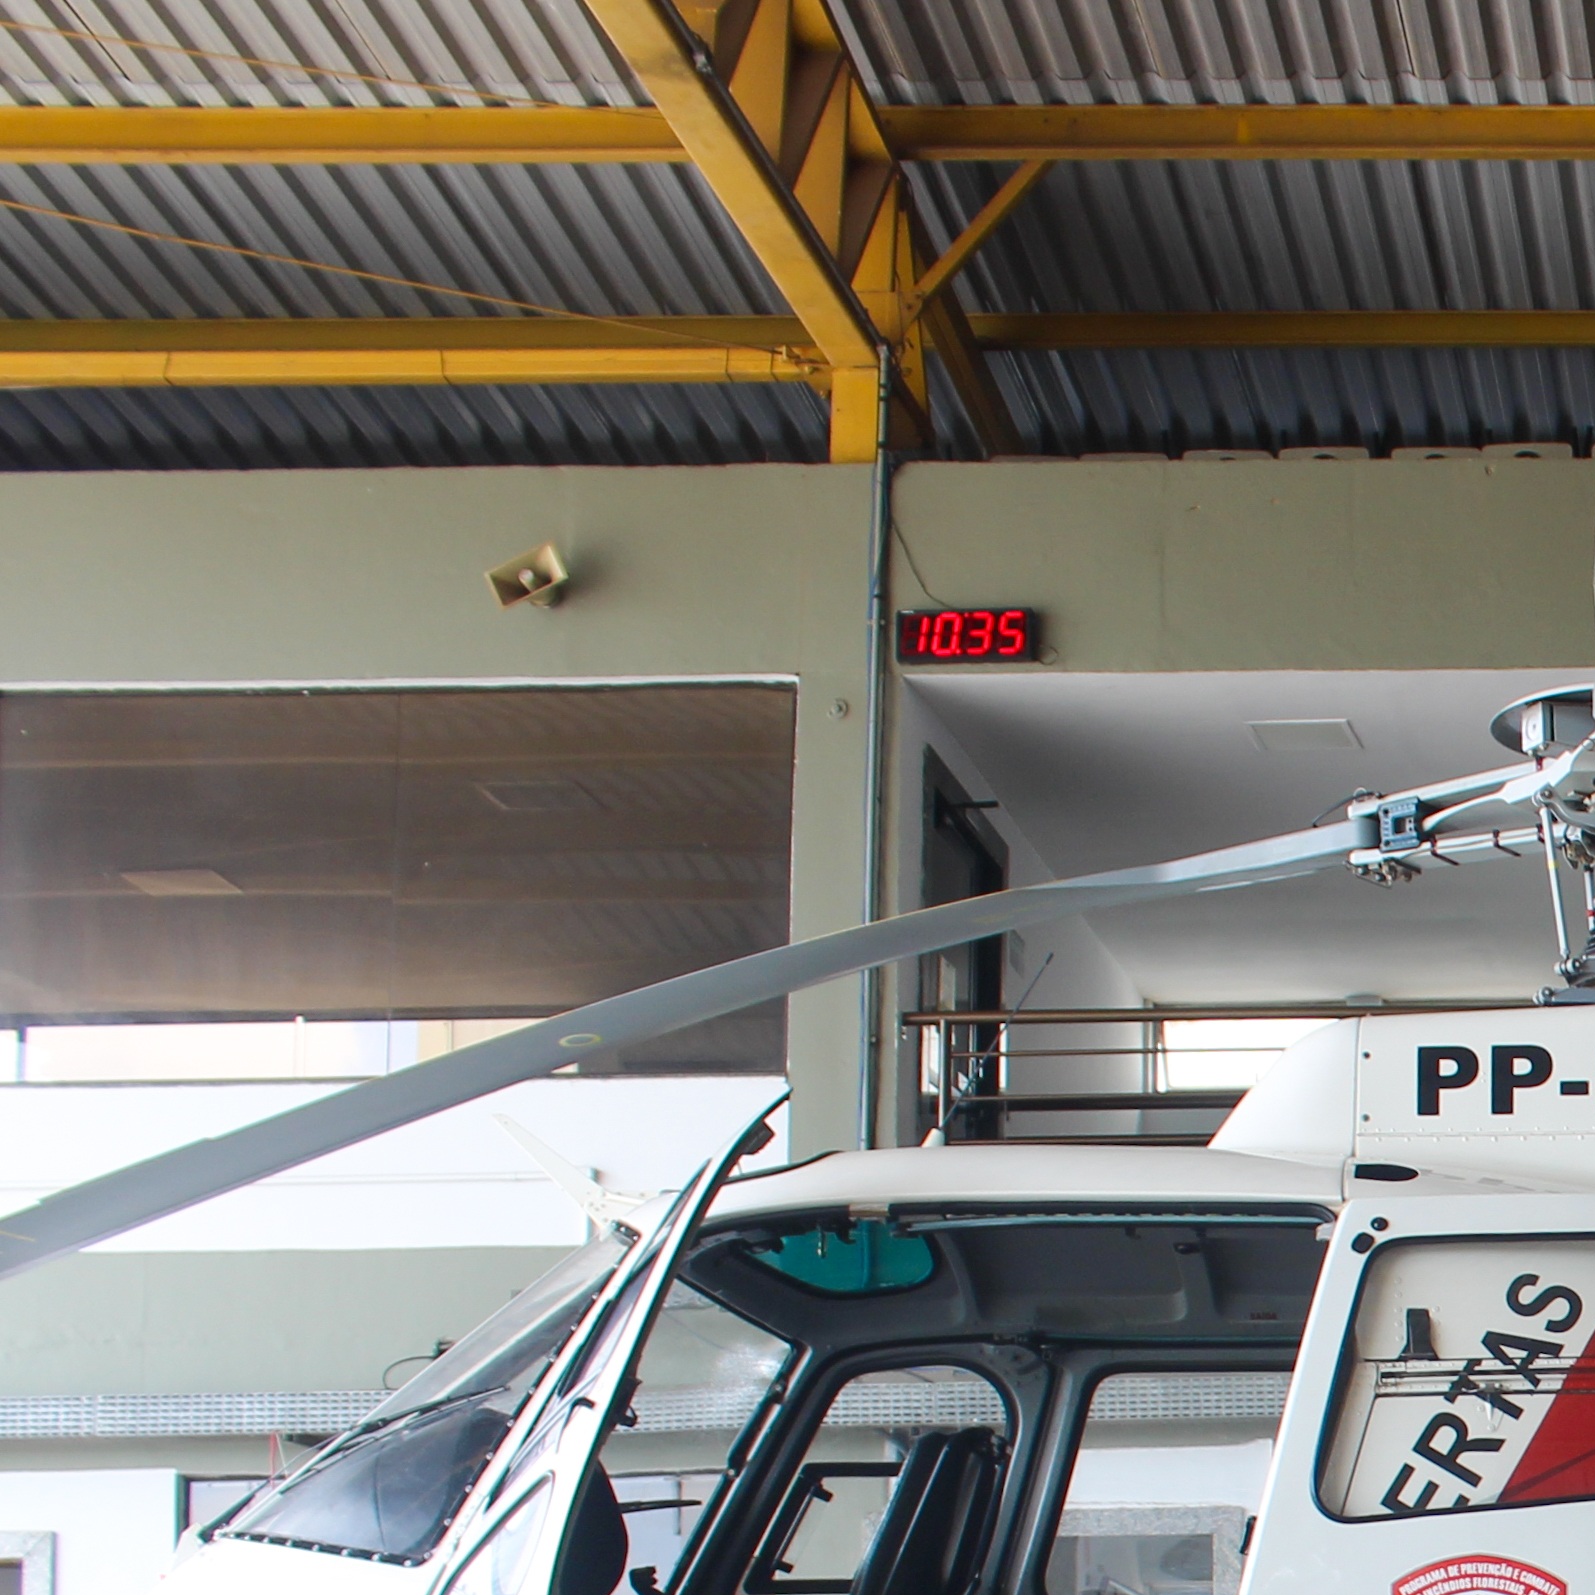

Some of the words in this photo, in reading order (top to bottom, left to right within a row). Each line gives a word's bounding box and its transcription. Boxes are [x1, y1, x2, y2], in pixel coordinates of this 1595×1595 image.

[1380, 1272, 1583, 1513] ERTAS
[1447, 1564, 1461, 1577] DE
[1460, 1562, 1513, 1577] PREVENÇÃO
[1514, 1567, 1521, 1579] E
